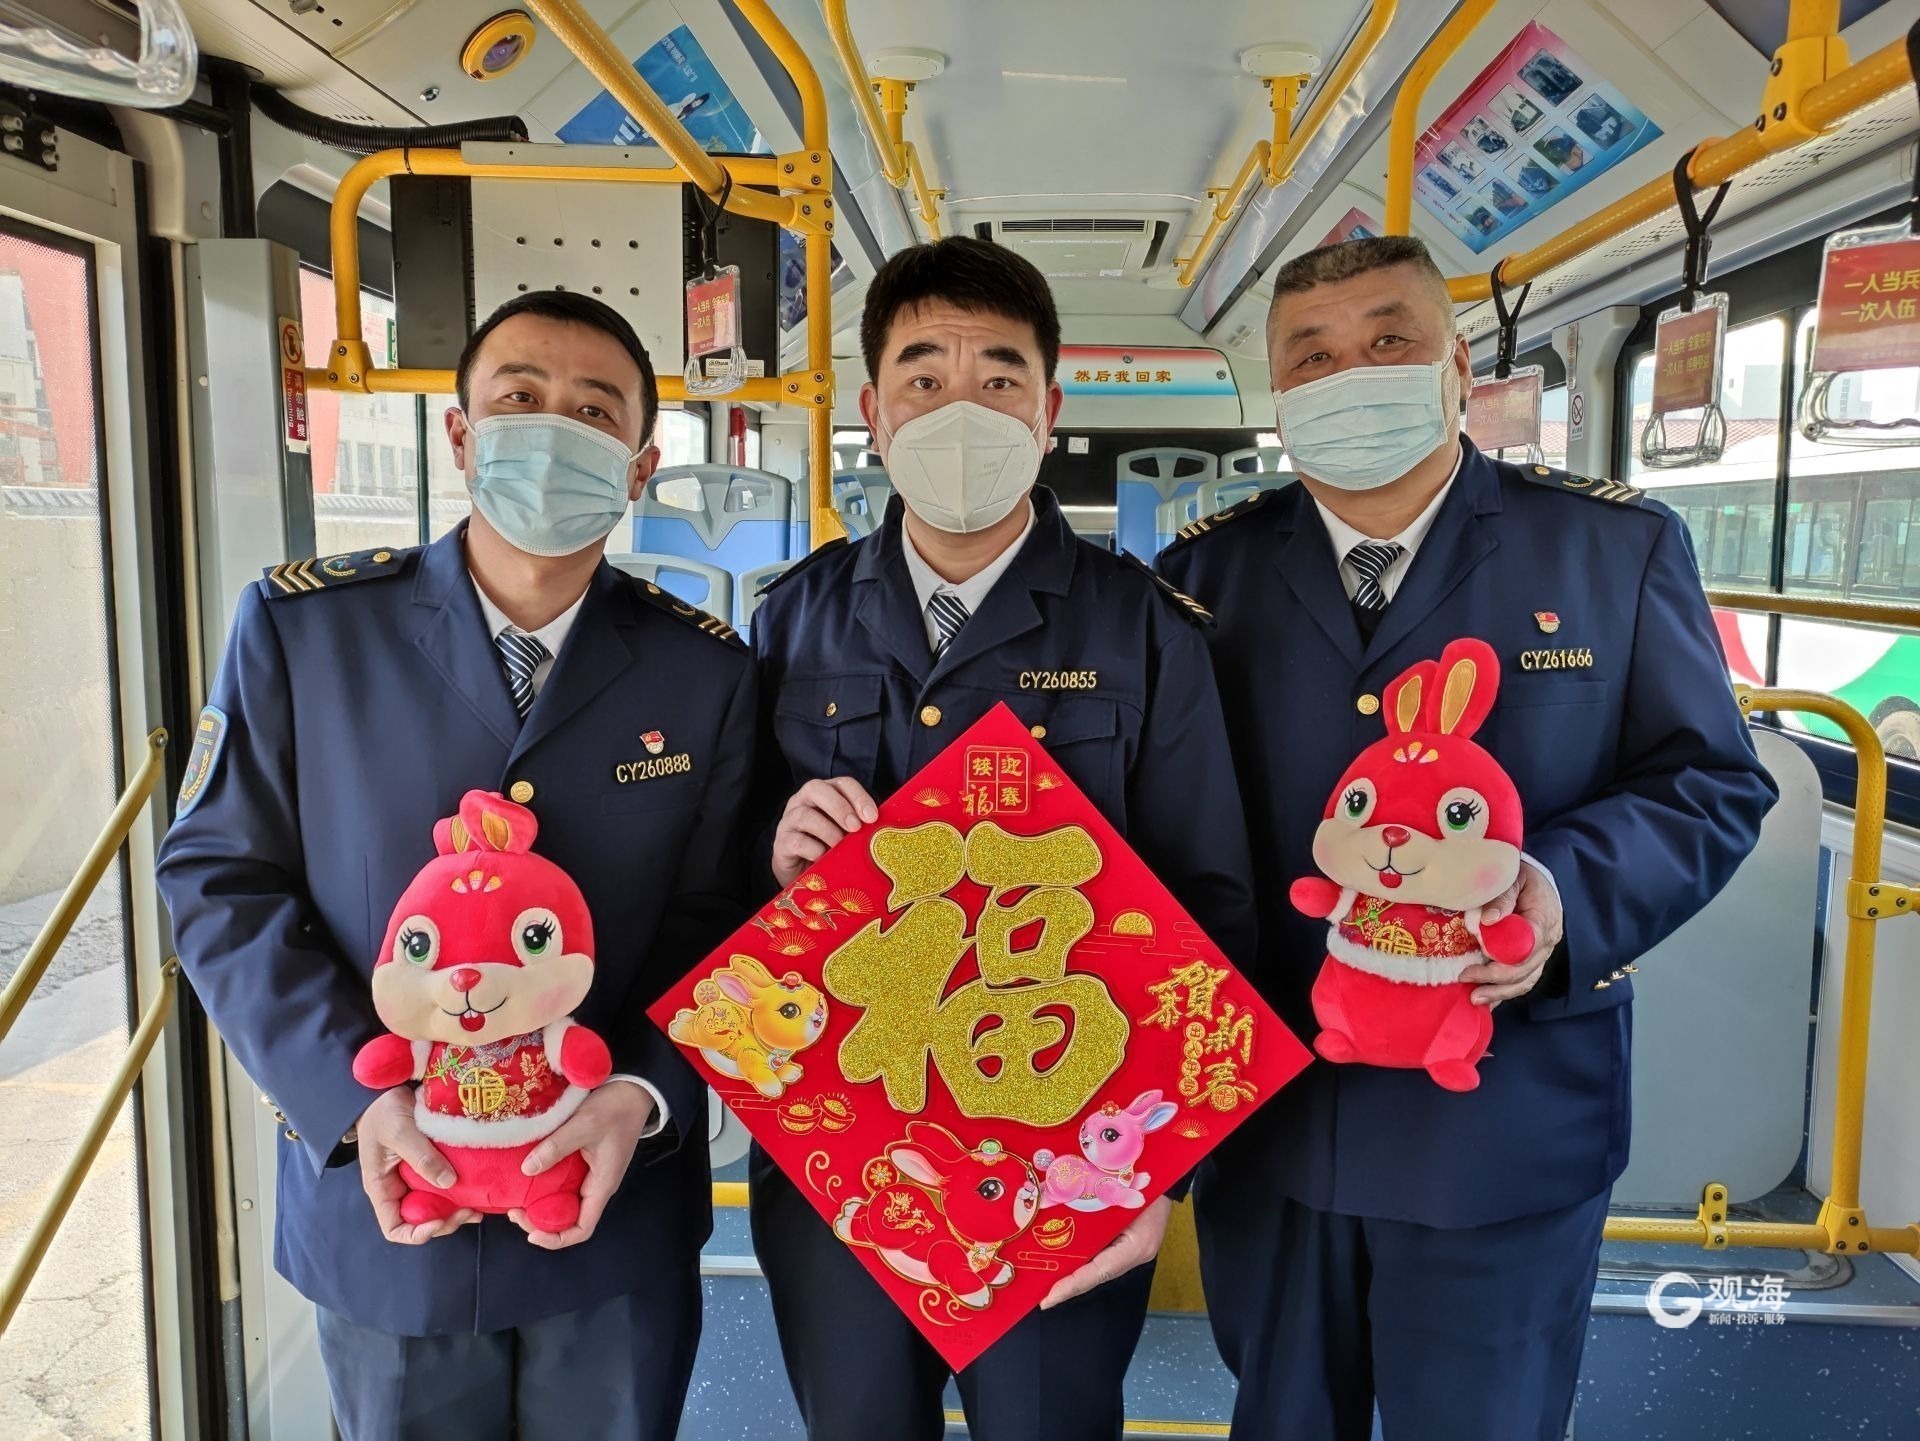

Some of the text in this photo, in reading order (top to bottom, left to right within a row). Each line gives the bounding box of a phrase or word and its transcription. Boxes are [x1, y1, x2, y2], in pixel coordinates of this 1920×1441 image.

[1843, 269, 1920, 294] 一人当兵
[1074, 369, 1172, 383] 然后我回家
[1521, 648, 1593, 670] CY261666
[1020, 671, 1097, 689] CY260855
[616, 753, 691, 783] CY260888
[822, 820, 1130, 1128] 福
[458, 1066, 505, 1114] 福
